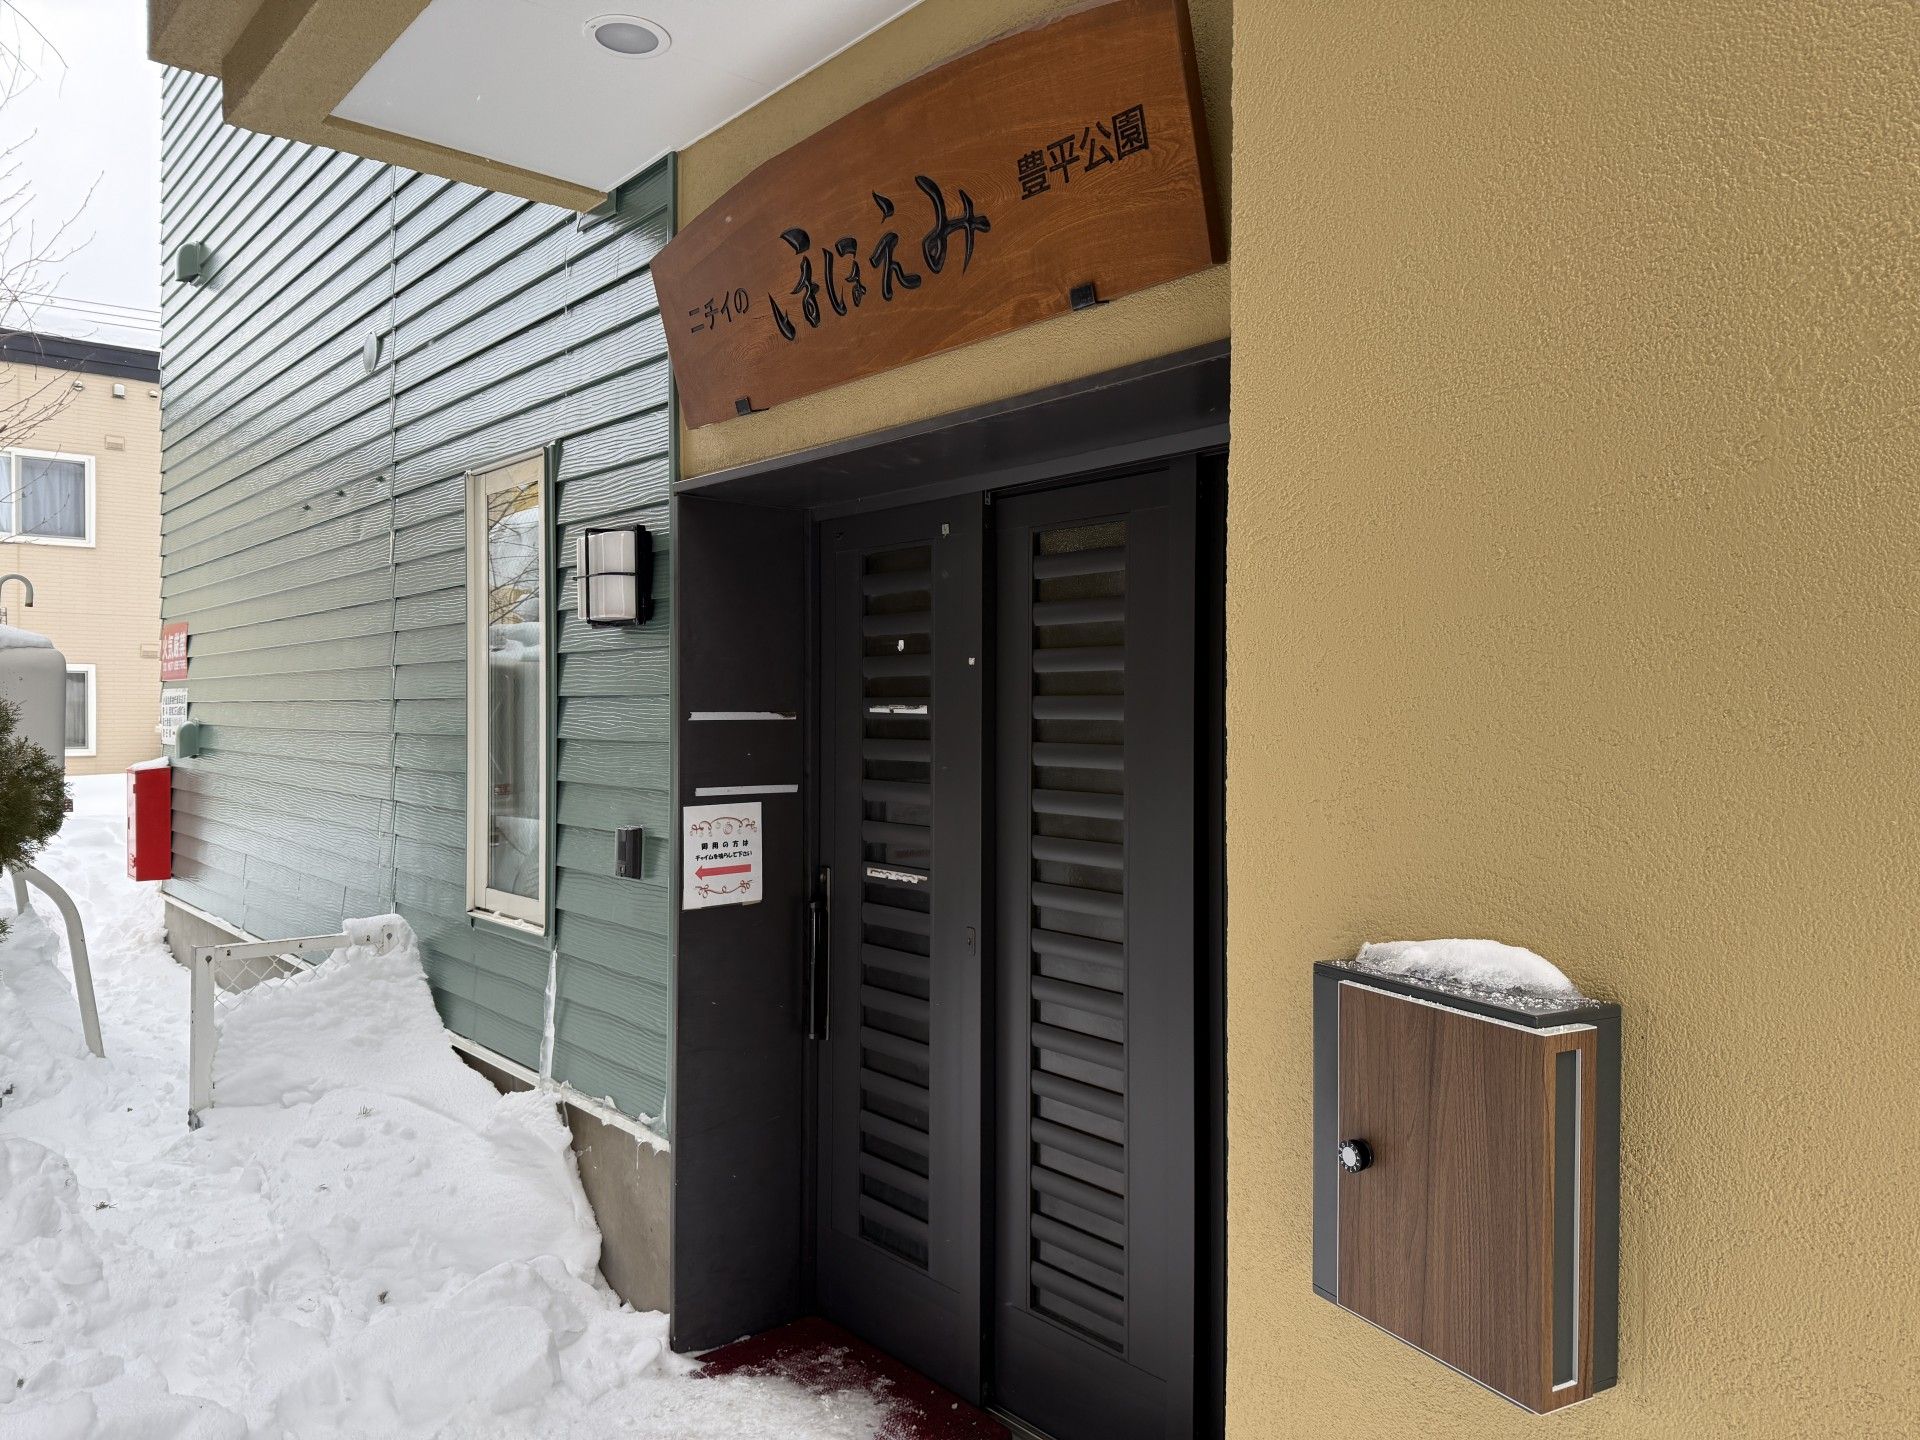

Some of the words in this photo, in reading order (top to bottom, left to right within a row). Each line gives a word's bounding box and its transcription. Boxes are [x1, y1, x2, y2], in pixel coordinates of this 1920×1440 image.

[688, 287, 750, 334] ニチイの
[768, 174, 991, 342] ほほえみ
[1016, 103, 1149, 201] 豊平公園
